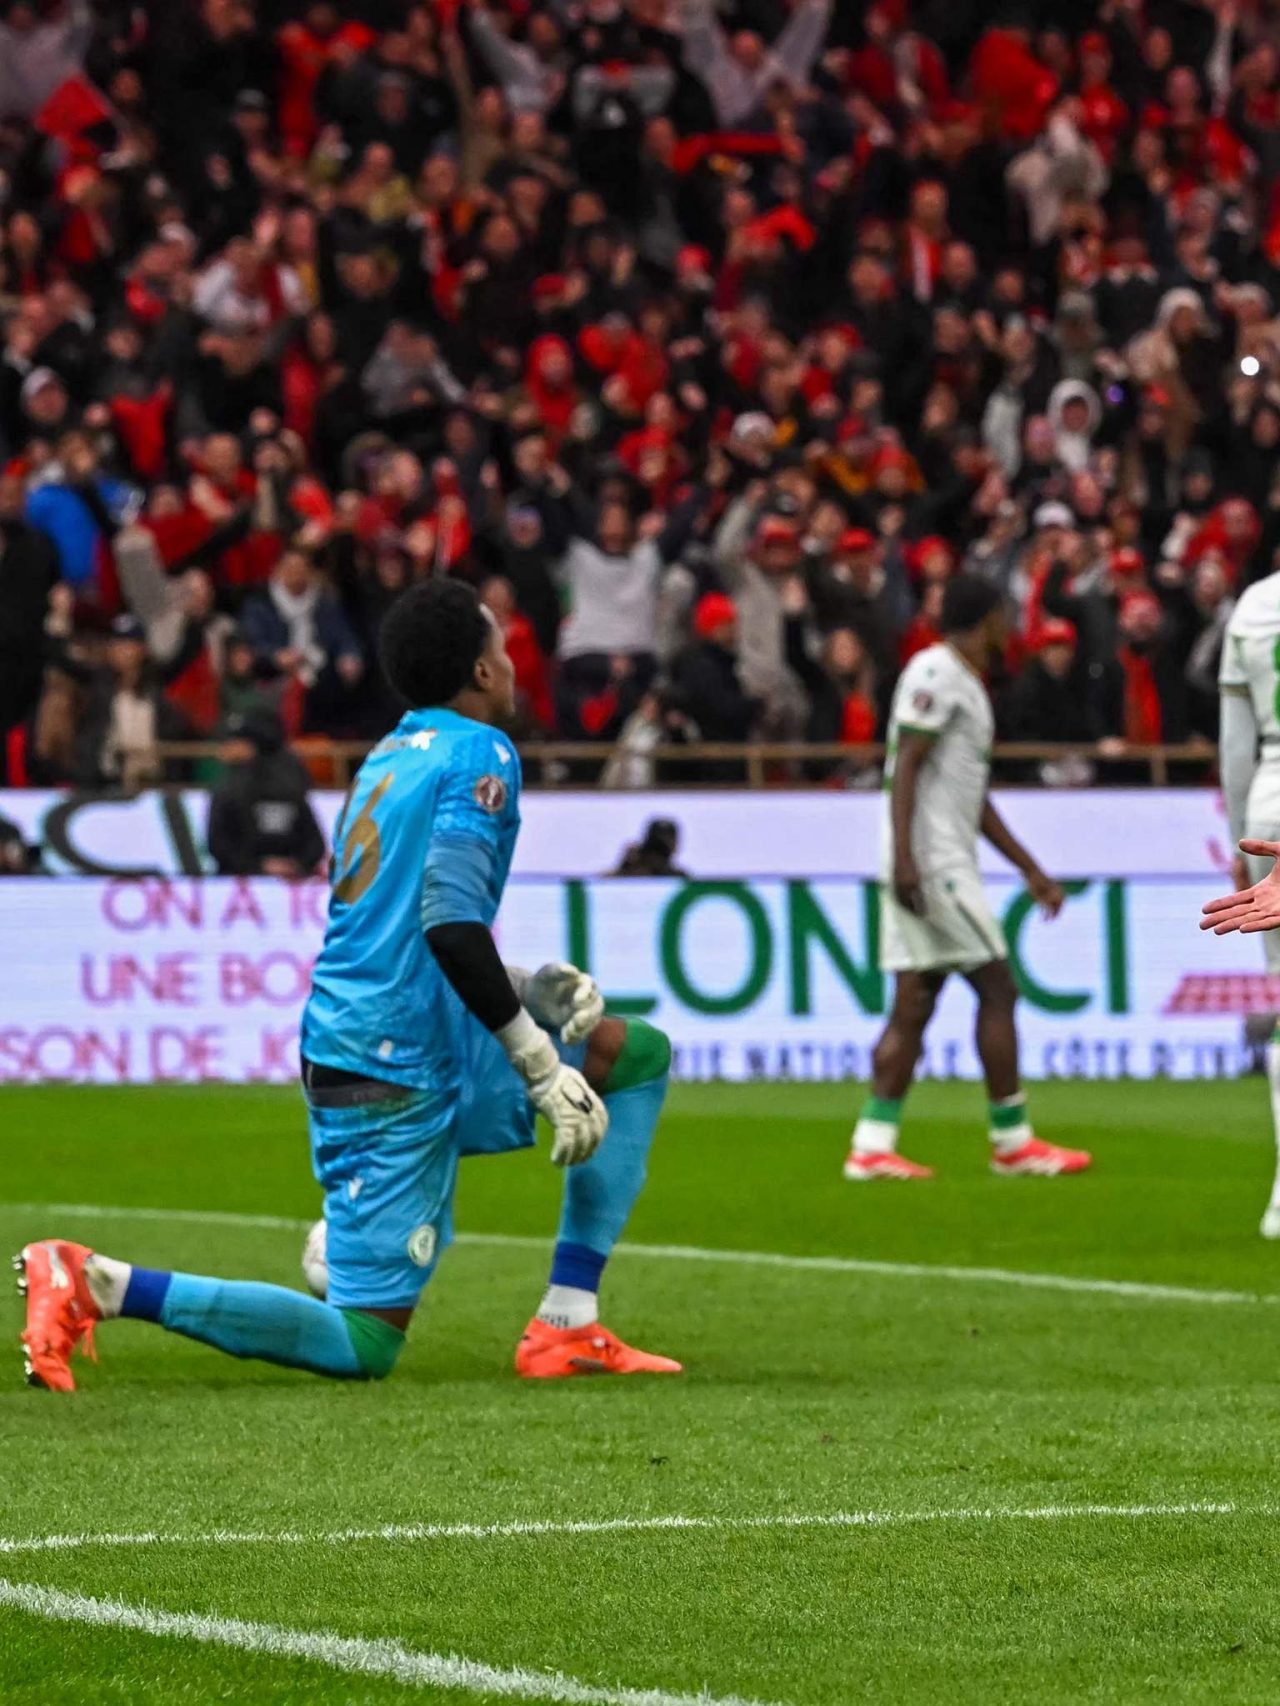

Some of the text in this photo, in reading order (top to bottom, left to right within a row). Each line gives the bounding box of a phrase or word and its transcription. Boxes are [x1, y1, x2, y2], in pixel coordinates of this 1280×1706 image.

[102, 874, 203, 930] ON
[220, 876, 264, 927] A
[562, 880, 1129, 1015] LONCI
[81, 951, 315, 1006] UNE BO
[148, 1025, 224, 1078] DE
